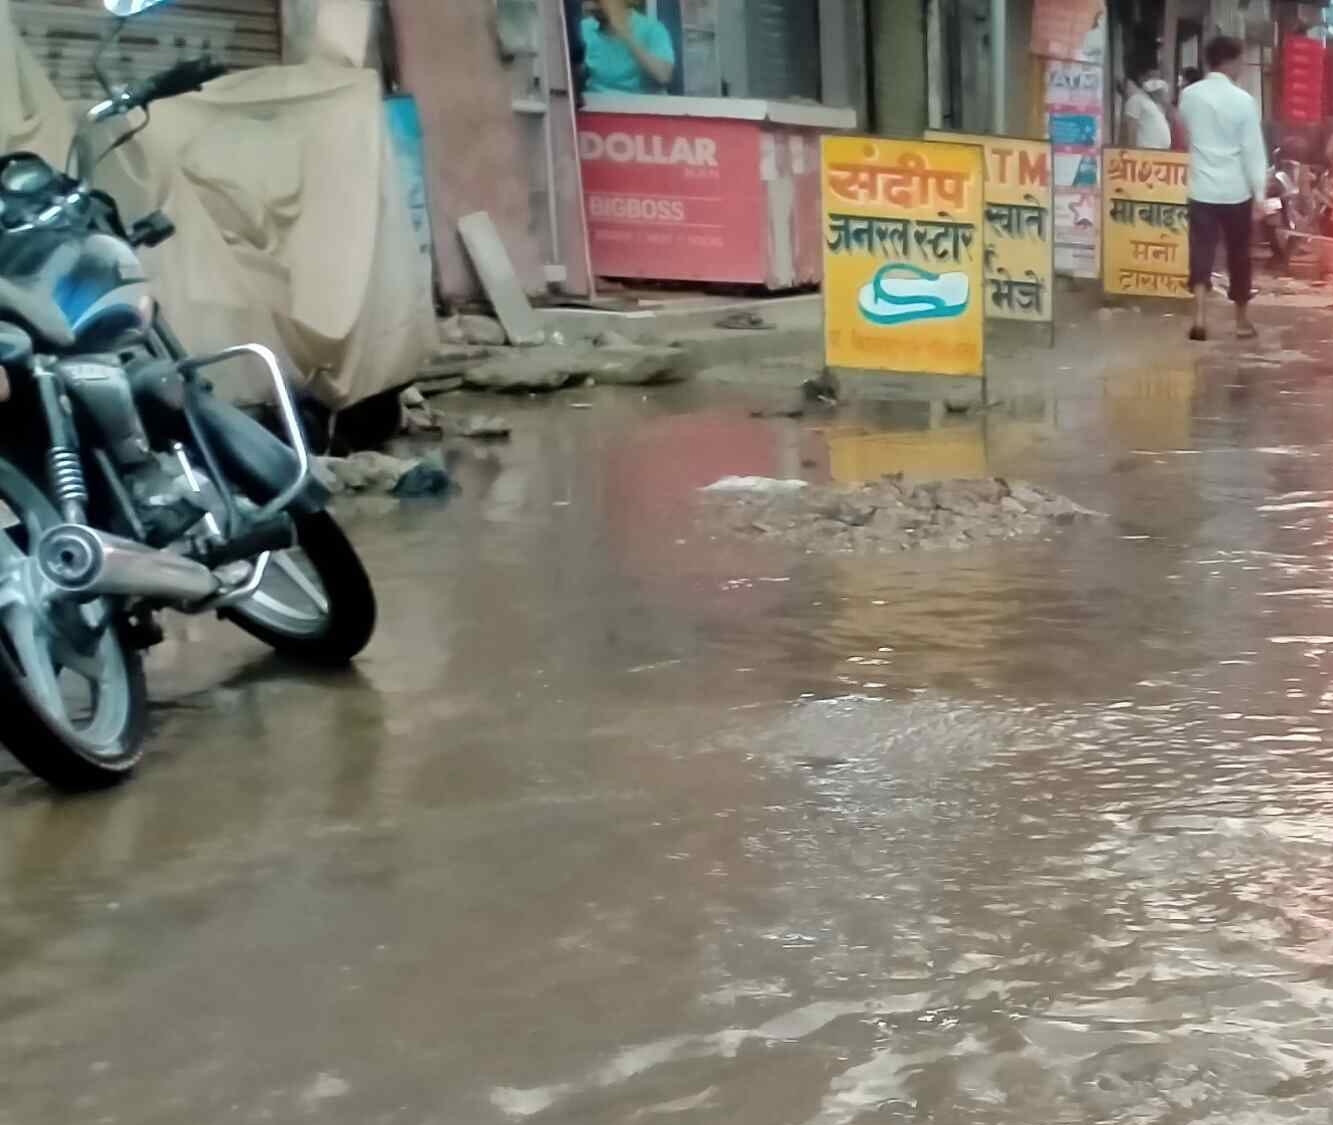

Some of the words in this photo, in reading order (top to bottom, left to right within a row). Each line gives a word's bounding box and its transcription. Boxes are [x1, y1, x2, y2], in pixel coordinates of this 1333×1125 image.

[579, 131, 719, 167] DOLLAR
[828, 144, 972, 208] संदीप
[589, 196, 685, 221] BIGBOSS
[827, 212, 911, 256] जनरल
[914, 211, 975, 262] स्टोर
